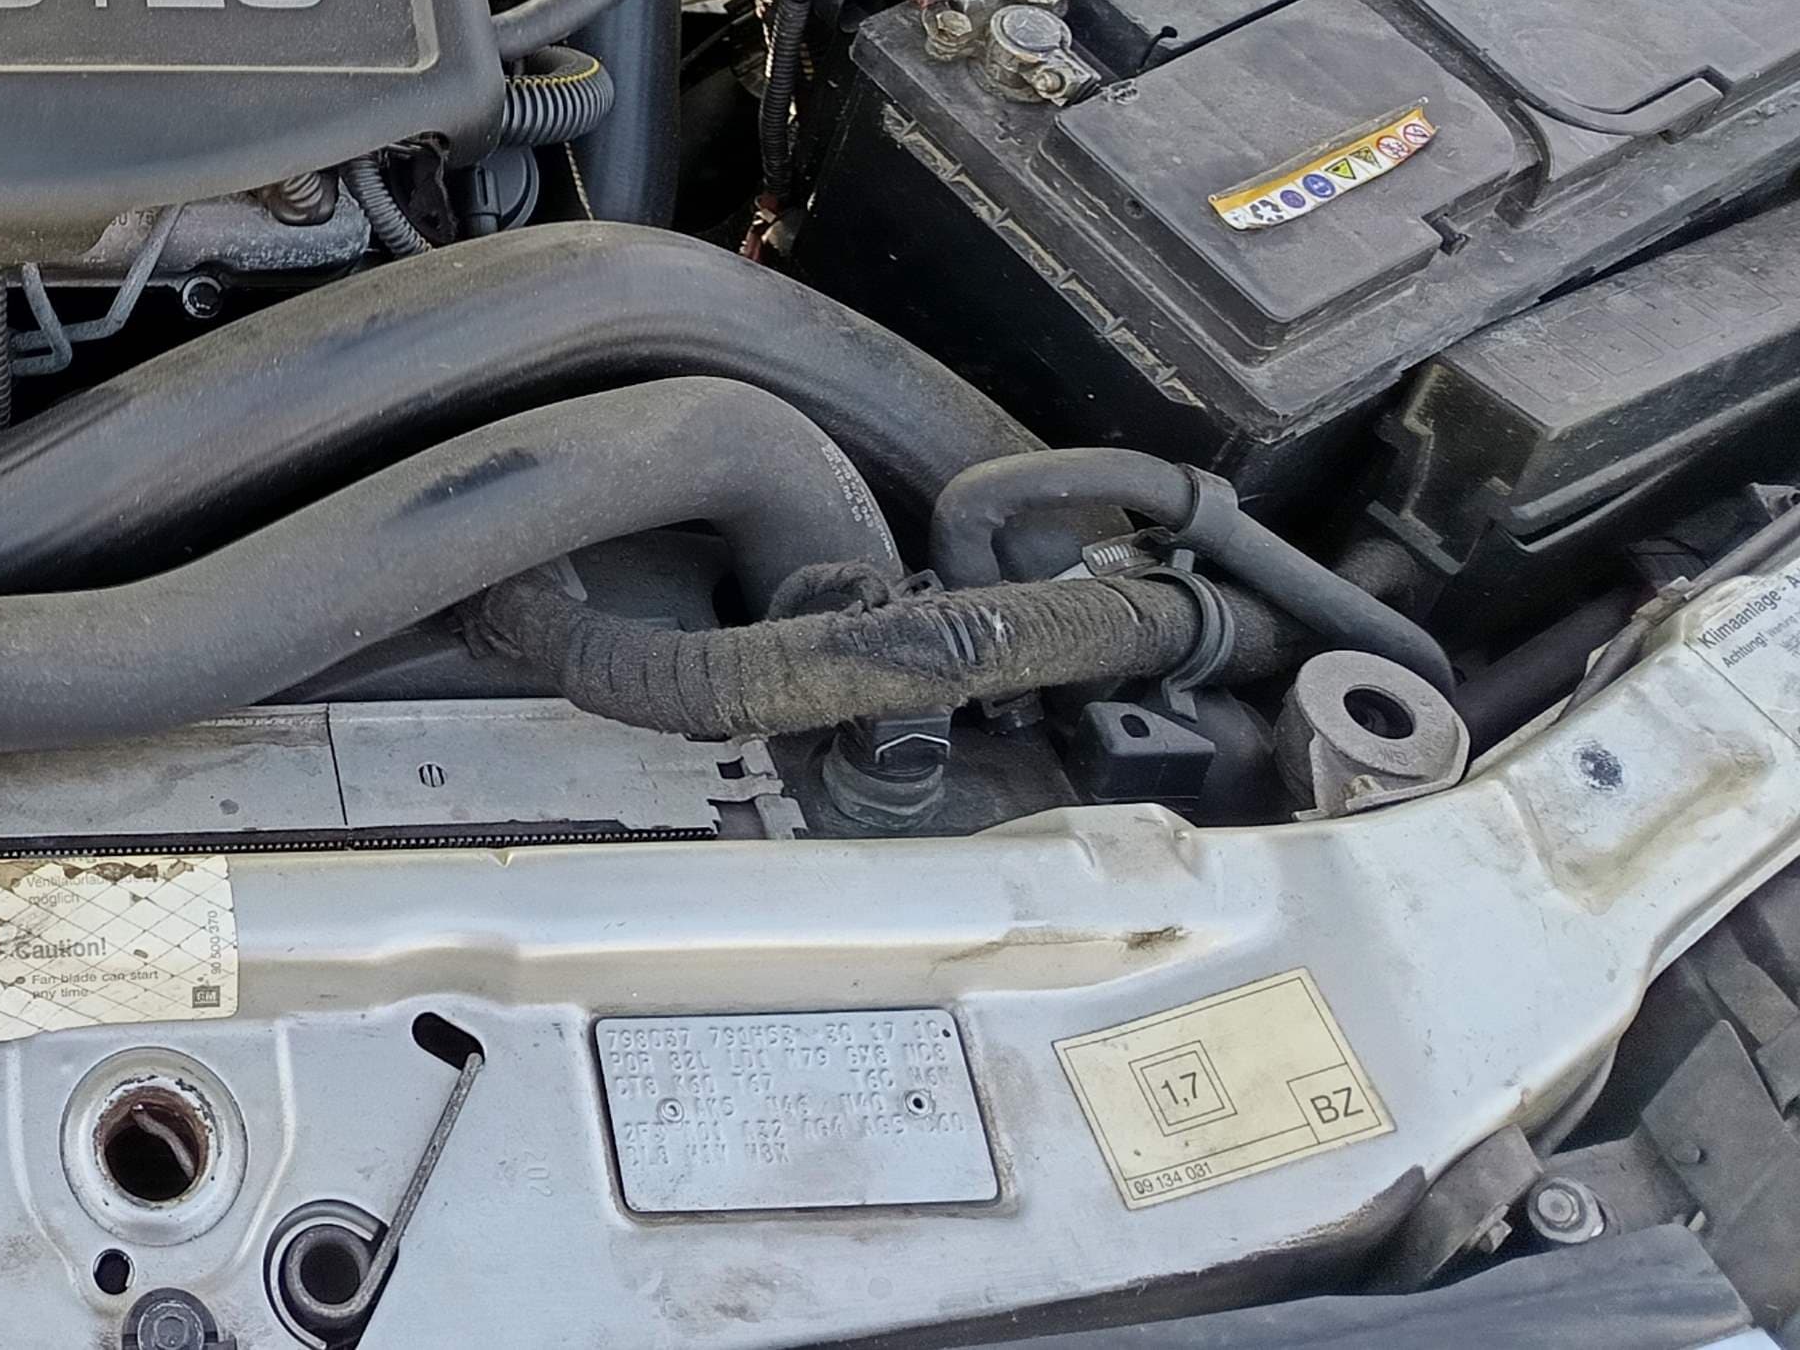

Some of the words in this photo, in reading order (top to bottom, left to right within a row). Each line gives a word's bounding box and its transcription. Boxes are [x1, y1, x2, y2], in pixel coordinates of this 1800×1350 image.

[1697, 590, 1783, 649] Klimaanlage
[1721, 632, 1769, 668] Achtung!
[29, 892, 80, 907] möglich
[207, 910, 220, 934] 370
[14, 937, 108, 960] Caution!
[209, 936, 222, 959] 500
[31, 974, 56, 985] Fan
[61, 972, 97, 984] blade
[101, 971, 125, 982] can
[130, 969, 159, 981] start
[209, 961, 222, 975] 90
[32, 988, 57, 1000] any
[60, 987, 89, 998] time
[1160, 1071, 1201, 1108] 1,7
[1310, 1086, 1364, 1126] BZ
[1133, 1178, 1156, 1196] 09
[1157, 1169, 1184, 1190] 134
[1187, 1161, 1214, 1182] 031
